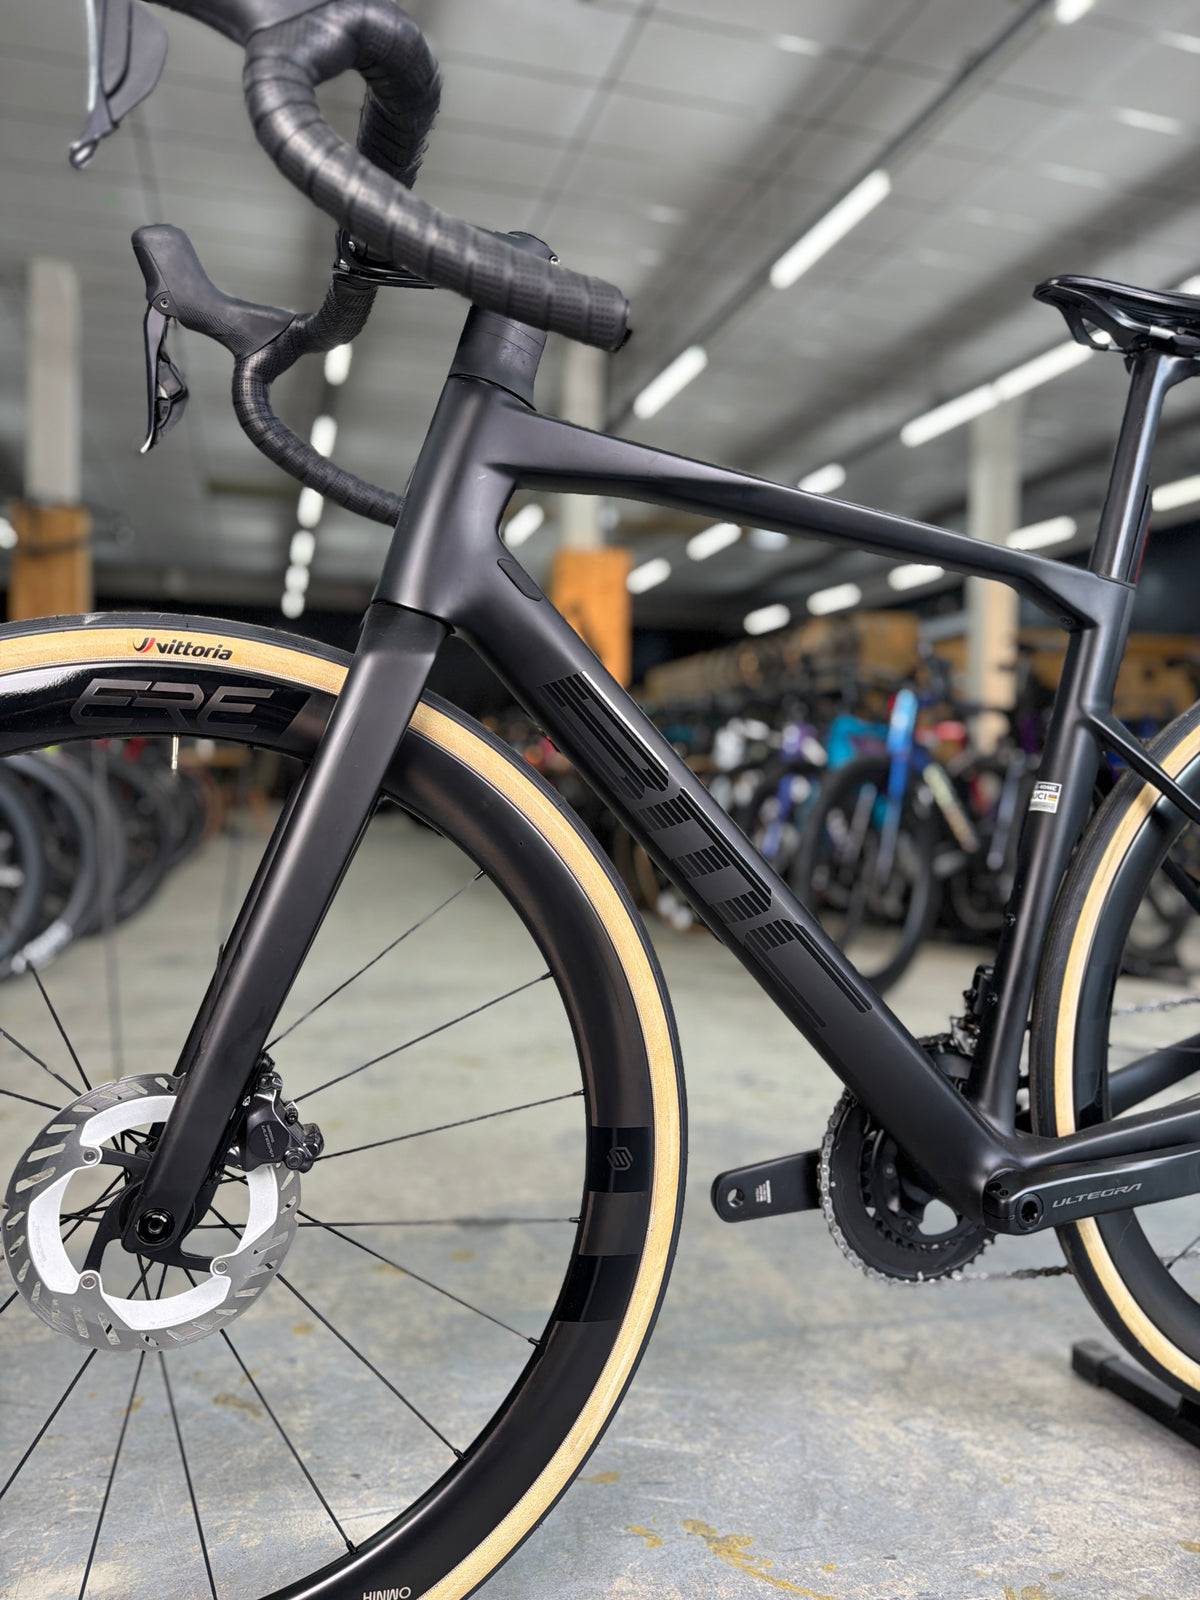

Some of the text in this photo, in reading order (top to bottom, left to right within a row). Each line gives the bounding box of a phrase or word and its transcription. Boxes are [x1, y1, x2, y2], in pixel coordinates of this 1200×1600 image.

[156, 639, 233, 661] vittoria
[70, 678, 275, 733] ERE
[1052, 1183, 1142, 1208] ULTEGRA
